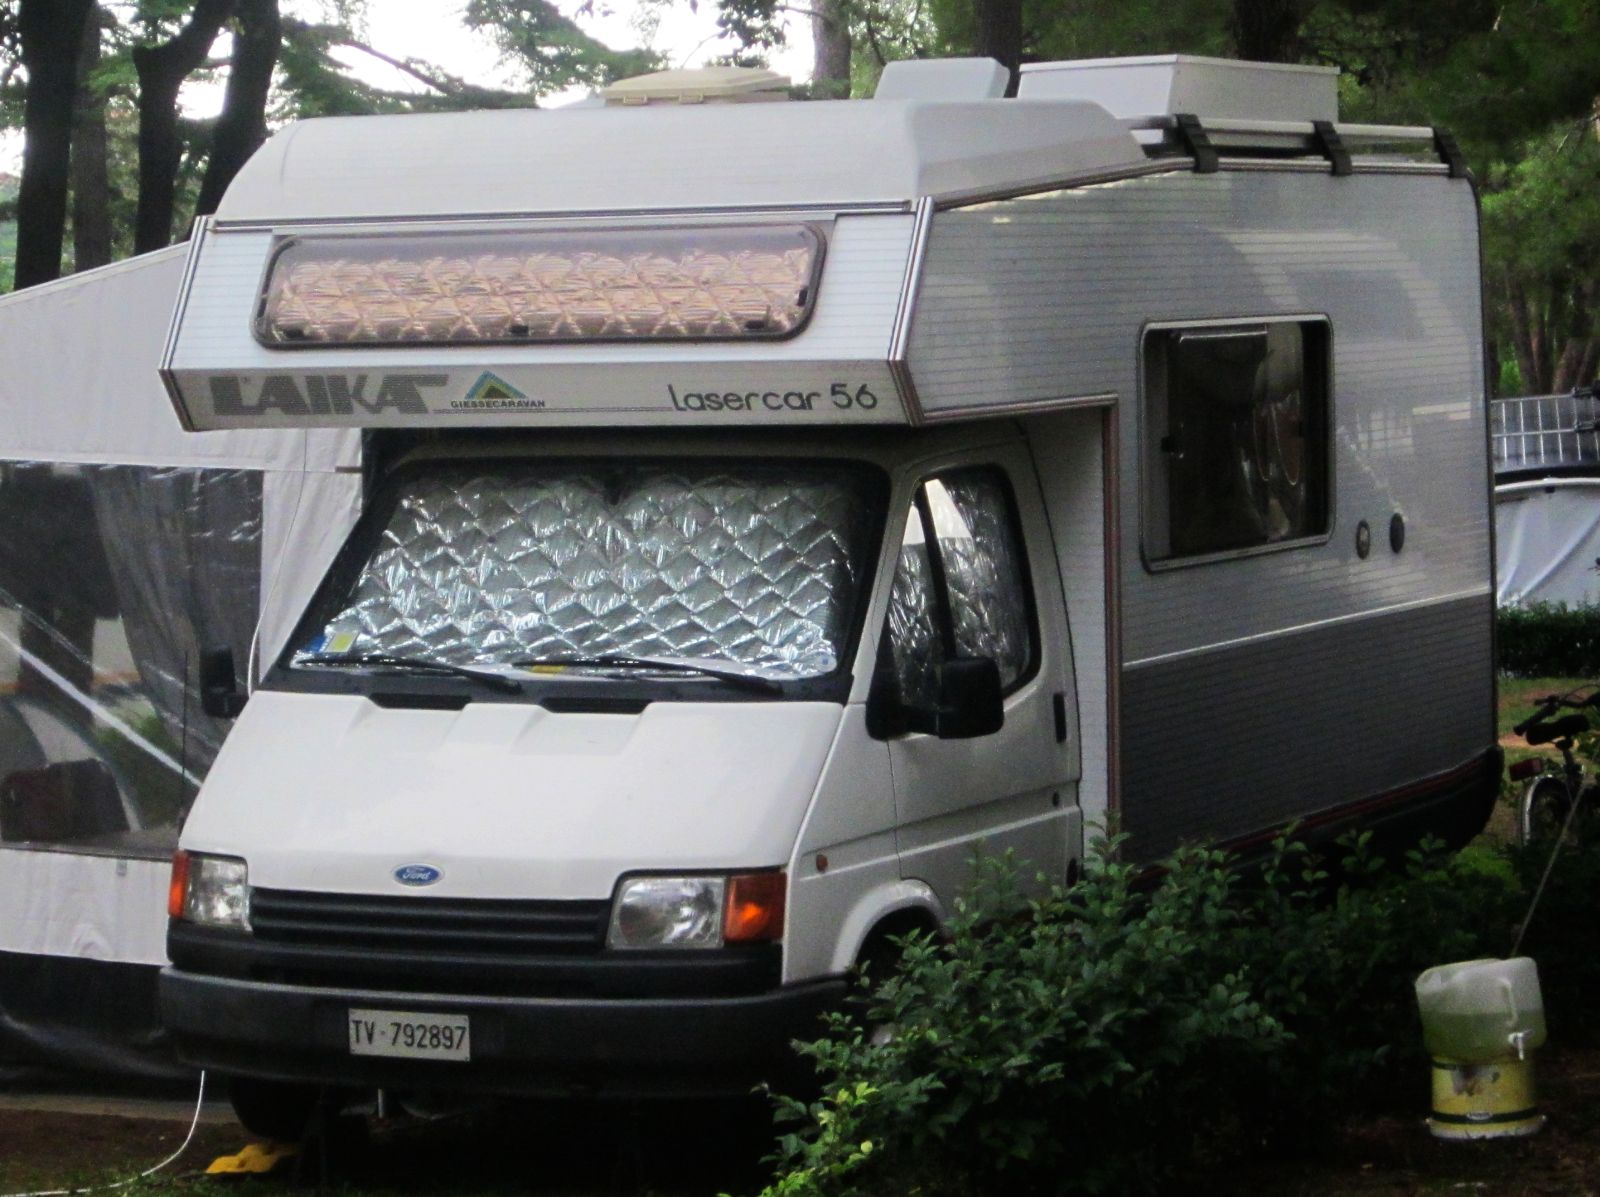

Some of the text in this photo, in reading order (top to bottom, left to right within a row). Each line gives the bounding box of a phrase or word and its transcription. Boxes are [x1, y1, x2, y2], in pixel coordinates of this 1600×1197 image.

[208, 373, 450, 416] LAIKA
[450, 400, 546, 409] GIESSECARAVAN
[830, 383, 878, 410] 56
[402, 868, 431, 881] Ford
